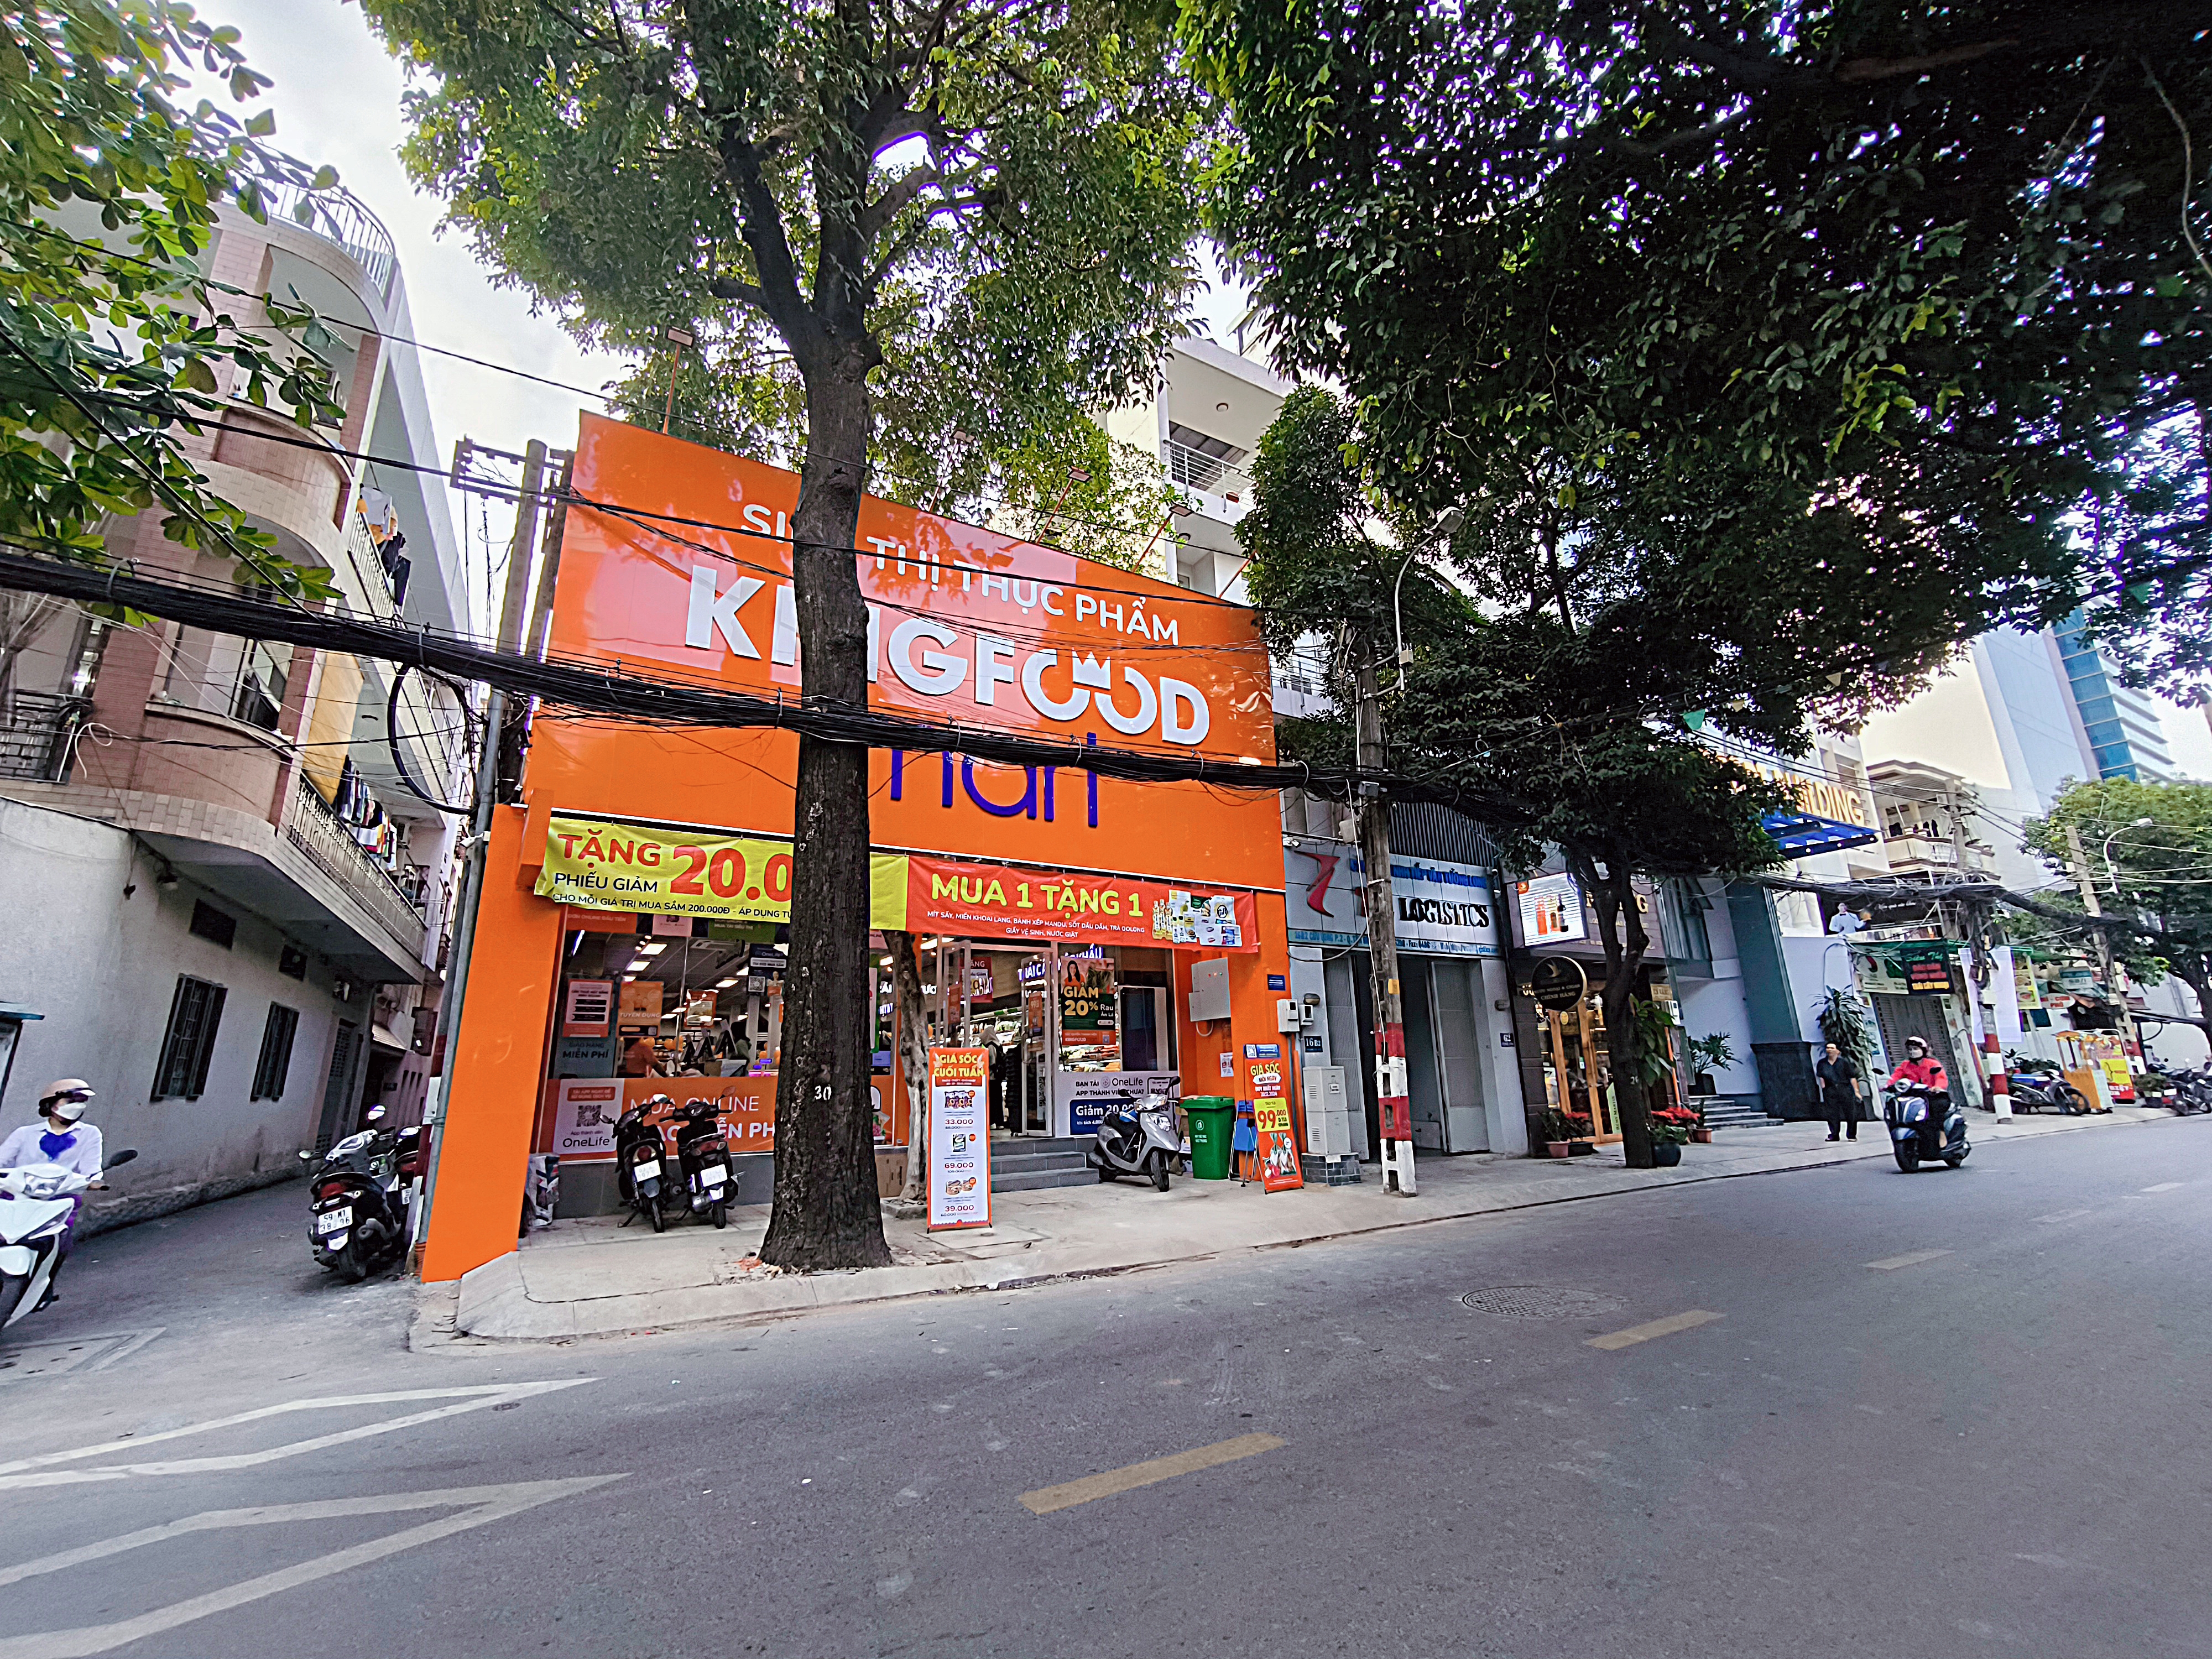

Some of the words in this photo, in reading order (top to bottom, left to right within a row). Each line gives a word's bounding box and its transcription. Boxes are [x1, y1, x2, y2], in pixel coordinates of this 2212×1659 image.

[867, 536, 939, 591] THỊ
[953, 560, 1064, 615] THỰC
[1076, 596, 1179, 646] PHẨM
[557, 828, 661, 868] TẶNG
[670, 844, 794, 902] 20.0
[555, 870, 608, 889] PHIẾU
[613, 875, 658, 893] GIẢM
[932, 873, 1008, 906] MUA
[1016, 882, 1034, 909] 1
[1040, 879, 1120, 919] TẶNG
[1128, 893, 1144, 917] 1
[553, 894, 576, 902] CHO
[600, 896, 618, 906] GIÁ
[620, 899, 636, 909] TRỊ
[638, 900, 662, 909] MUA
[687, 904, 731, 914] 200.000Đ
[738, 906, 752, 915] ÁP
[754, 909, 780, 919] DỤNG
[1398, 897, 1490, 928] LOGISTICS
[1005, 927, 1020, 935] GIẤY
[1021, 928, 1029, 936] VỆ
[1063, 982, 1099, 999] GIẢM
[1065, 999, 1099, 1016] 20%
[591, 1049, 609, 1058] PHÍ
[939, 1053, 957, 1063] GIÁ
[959, 1052, 978, 1064] SỐC
[933, 1065, 957, 1077] CUỐI
[958, 1065, 984, 1077] TUẦN
[1250, 1063, 1264, 1076] GIÁ
[1265, 1060, 1280, 1073] SỐC
[1112, 1077, 1143, 1086] OneLife
[815, 1085, 832, 1100] 30
[1076, 1104, 1104, 1116] Giảm
[562, 1136, 610, 1147] OneLife
